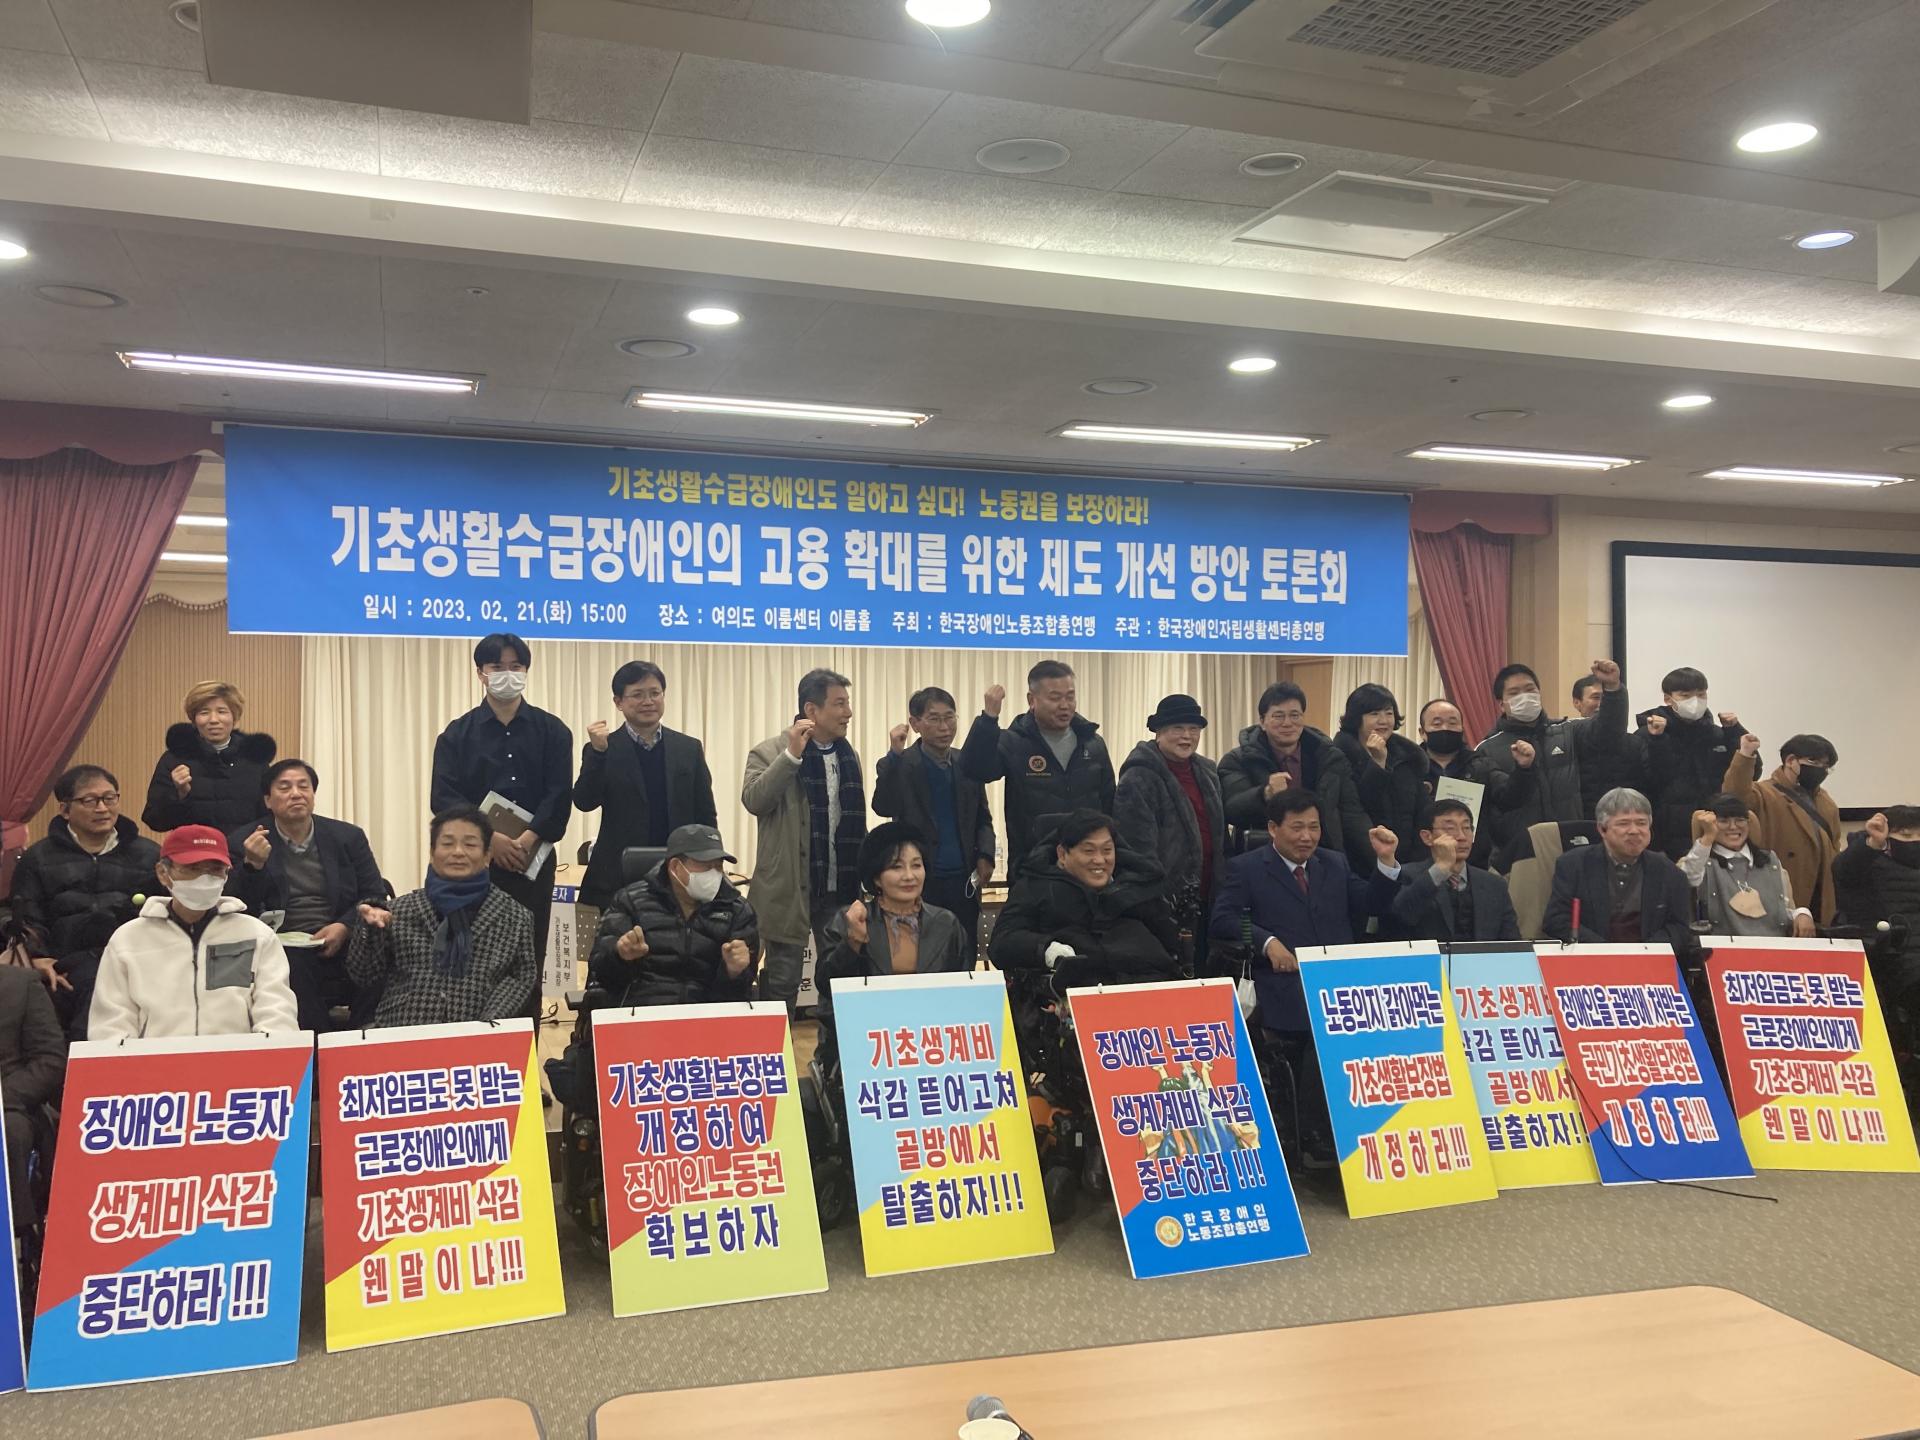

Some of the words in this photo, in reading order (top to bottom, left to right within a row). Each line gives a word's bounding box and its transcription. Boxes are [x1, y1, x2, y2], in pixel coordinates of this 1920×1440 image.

[608, 466, 837, 510] 기초생활수급장애인도
[846, 481, 909, 514] 일하고
[917, 486, 965, 517] 싶다!
[980, 489, 1058, 522] 노동권을
[1066, 494, 1148, 526] 보장하라!
[331, 505, 741, 586] 기초생활수급장애인의
[760, 526, 830, 590] 고용
[844, 528, 947, 593] 확대를
[962, 533, 1027, 596] 위한
[1039, 538, 1102, 598] 제도
[1115, 542, 1176, 600] 개선
[1190, 545, 1249, 603] 방안
[1261, 548, 1348, 605] 토론회
[363, 595, 397, 619] 일시
[422, 599, 471, 621] 2023.
[481, 600, 508, 622] 02.
[581, 602, 627, 624] 15:00
[659, 603, 689, 627] 장소
[711, 605, 756, 628] 여의도
[764, 607, 821, 630] 이룸센터
[830, 609, 871, 632] 이룸홀
[892, 611, 920, 633] 주최
[939, 611, 1096, 637] 한국장애인노동조합총연맹
[1115, 616, 1141, 638] 주관
[1158, 617, 1325, 641] 한국장애인자립생활센터총연맹
[1321, 986, 1384, 1032] 노동의지
[1556, 986, 1615, 1029] 장애인을
[1608, 987, 1653, 1028] 골방에
[1725, 972, 1808, 1004] 최저임금도
[1807, 975, 1828, 1006] 못
[1827, 975, 1864, 1006] 받는
[867, 1023, 996, 1069] 기초생계비
[1094, 1027, 1166, 1070] 장애인
[1166, 1022, 1236, 1063] 노동자
[1743, 1015, 1860, 1050] 근로장애인에게
[609, 1054, 788, 1106] 기초생활보장법
[1345, 1054, 1452, 1105] 기초생활보장법
[1487, 1068, 1577, 1106] 골방에서
[1581, 1041, 1701, 1085] 국민기초생활보장법
[1752, 1060, 1839, 1096] 기초생계비
[1840, 1063, 1877, 1097] 삭감
[341, 1067, 449, 1120] 최저임금도
[454, 1068, 476, 1107] 못
[479, 1065, 522, 1104] 받는
[858, 1079, 910, 1120] 삭감
[918, 1070, 1019, 1116] 뜯어고쳐
[1111, 1088, 1206, 1136] 생계계비
[1207, 1083, 1254, 1125] 삭감
[83, 1095, 184, 1151] 장애인
[193, 1088, 291, 1141] 노동자
[358, 1121, 509, 1177] 근로장애인에게
[895, 1122, 1001, 1172] 골방에서
[624, 1151, 785, 1210] 장애인노동권
[881, 1172, 1025, 1228] 탈출하자!!!
[1136, 1151, 1231, 1202] 중단하라
[92, 1179, 198, 1240] 생계비
[205, 1174, 275, 1229] 삭감
[359, 1184, 472, 1240] 기초생계비
[476, 1178, 521, 1221] 삭감
[1187, 1218, 1271, 1242] 노동조합총연맹
[81, 1267, 223, 1336] 중단하라
